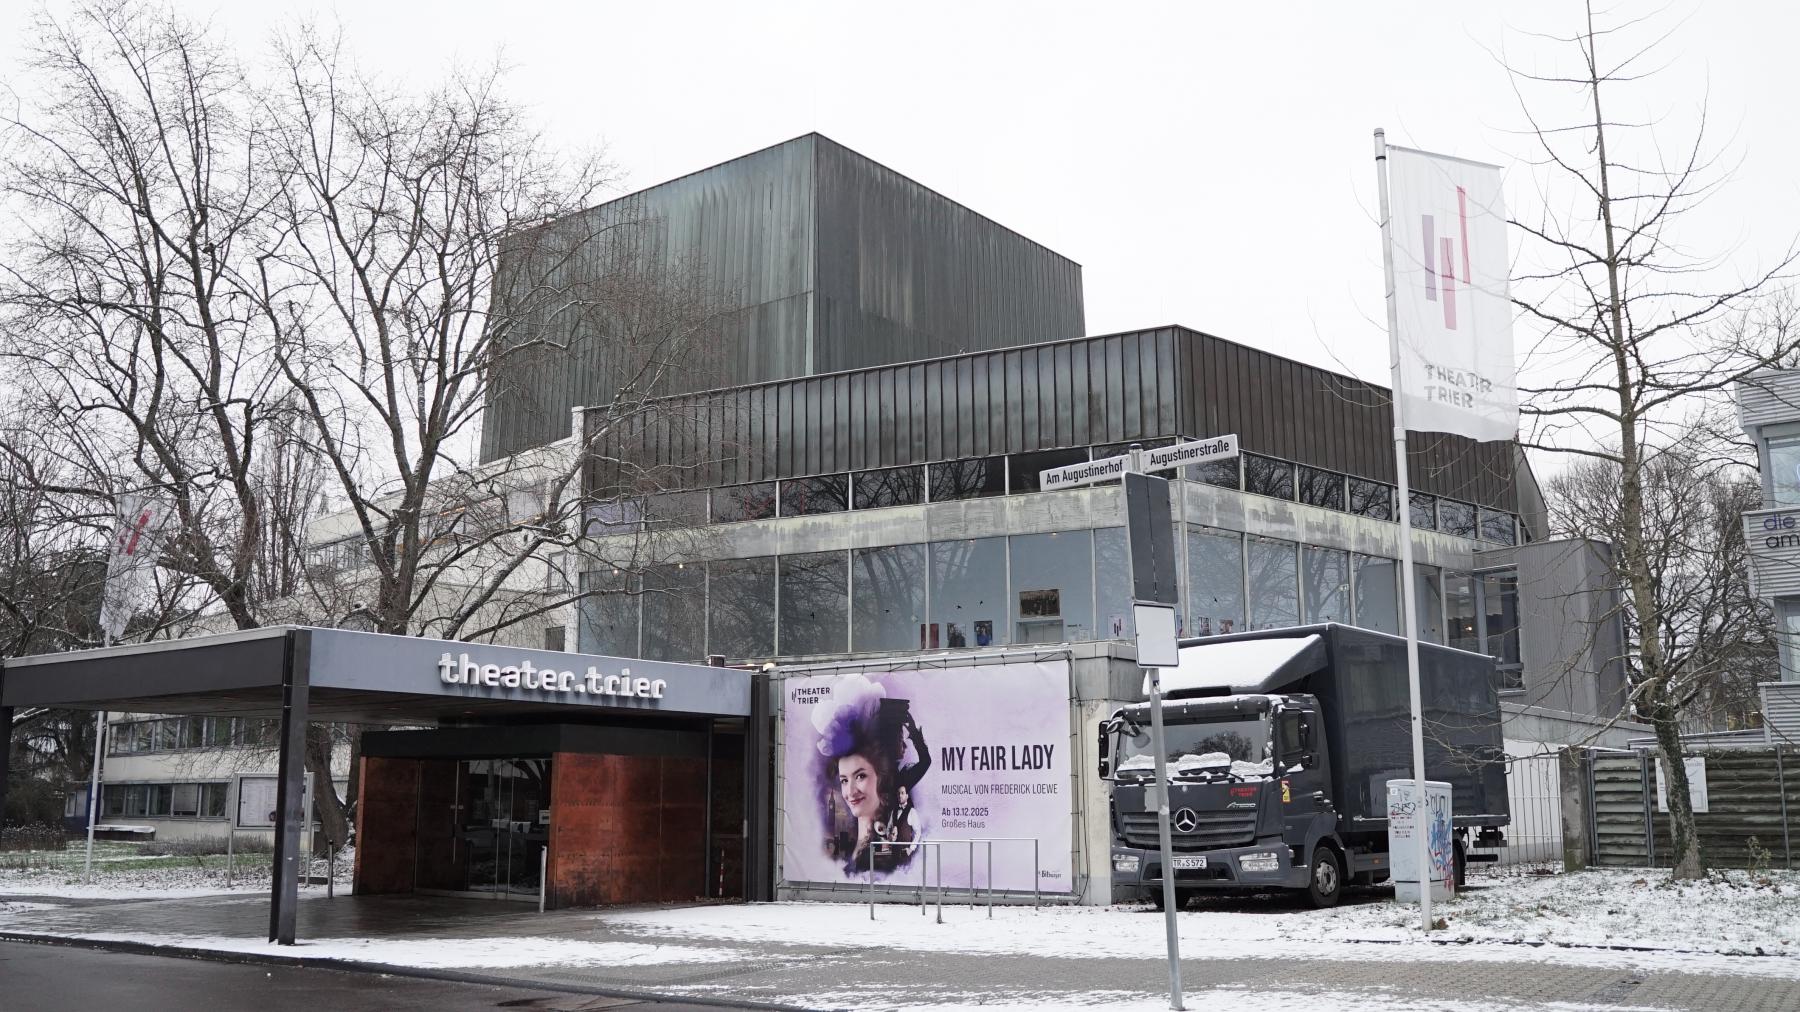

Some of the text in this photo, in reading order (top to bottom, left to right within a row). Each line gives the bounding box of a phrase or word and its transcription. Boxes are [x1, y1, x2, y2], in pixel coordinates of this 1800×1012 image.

[1424, 385, 1473, 408] TRIER
[1150, 440, 1229, 467] Augustinerstraße
[1046, 461, 1123, 485] Am Augustinerhof
[1763, 512, 1795, 530] die
[438, 653, 667, 699] theater.trier
[797, 687, 831, 695] THEATER
[941, 744, 1054, 771] MY FAIR LADY
[941, 783, 1058, 795] MUSICAL VON FREDERICK LOEWE
[941, 807, 989, 817] Ab 13.12.2025
[941, 819, 986, 829] Großes Haus
[1191, 859, 1204, 867] 572
